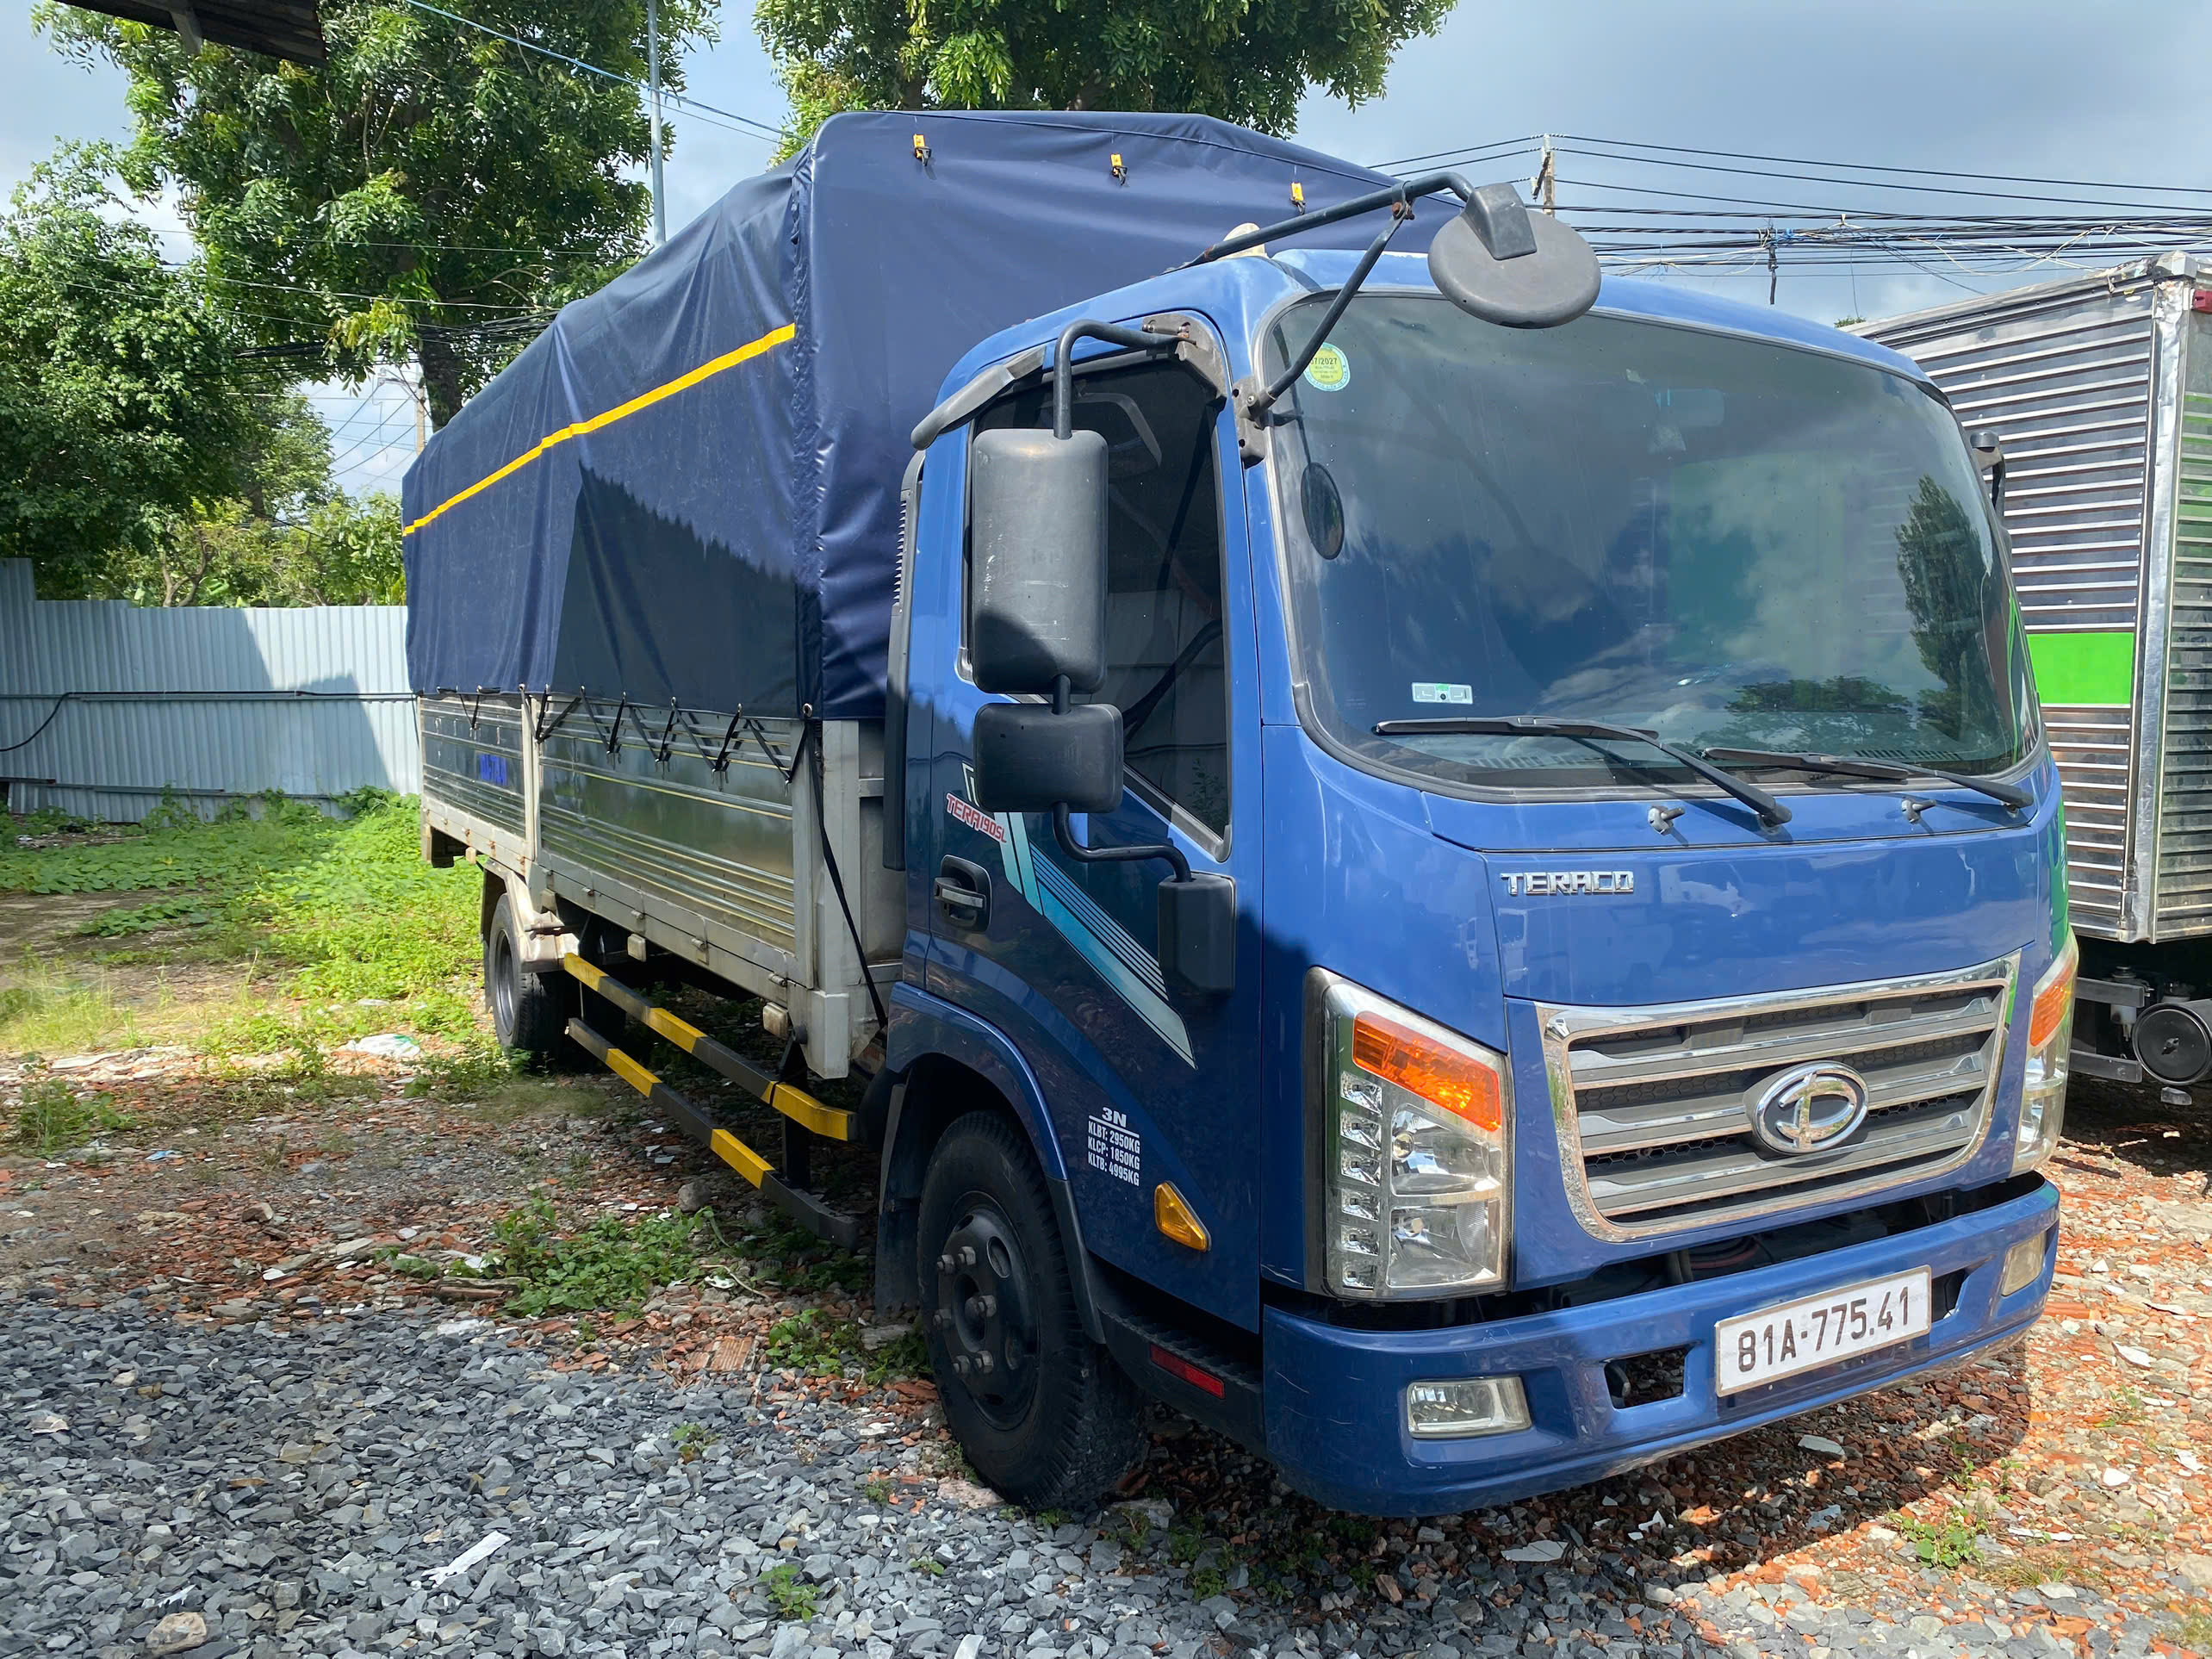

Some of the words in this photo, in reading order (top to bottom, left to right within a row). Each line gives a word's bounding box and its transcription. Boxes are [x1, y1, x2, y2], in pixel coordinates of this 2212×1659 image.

[1500, 871, 1634, 897] TERACO
[1102, 1107, 1127, 1128] 3N
[1088, 1121, 1108, 1141] KLBT:
[1109, 1130, 1140, 1154] 2950KG
[1088, 1136, 1109, 1157] KLCP:
[1110, 1146, 1140, 1171] 1850KG
[1088, 1151, 1108, 1172] KLTB:
[1109, 1161, 1140, 1186] 4995KG
[1738, 1286, 1908, 1372] 81A-775.41
